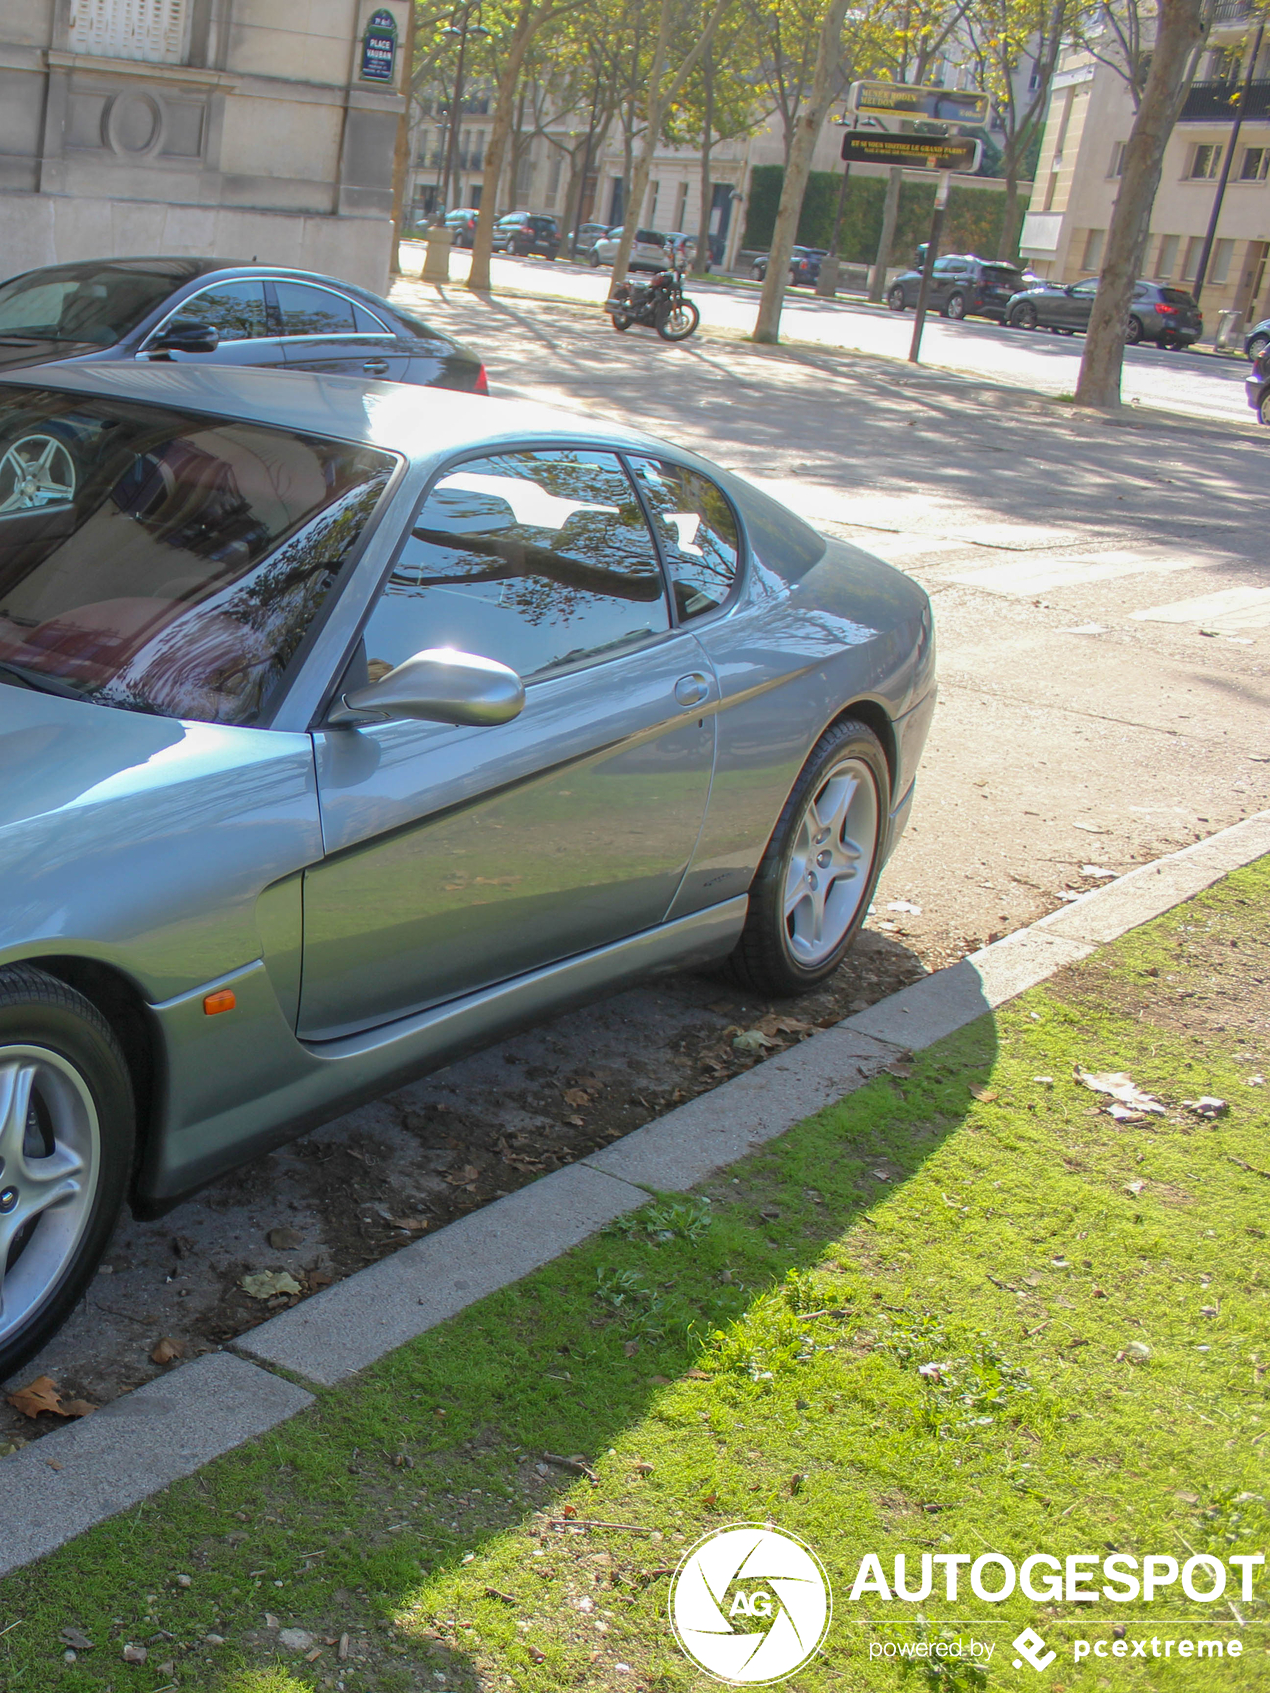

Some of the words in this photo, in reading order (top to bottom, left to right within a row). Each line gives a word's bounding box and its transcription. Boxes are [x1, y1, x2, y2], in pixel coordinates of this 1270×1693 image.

[370, 38, 391, 49] PLACE
[367, 49, 391, 60] VAUBAN
[861, 97, 895, 107] MEUDON
[890, 92, 917, 102] RODIN
[920, 145, 943, 153] GRAND
